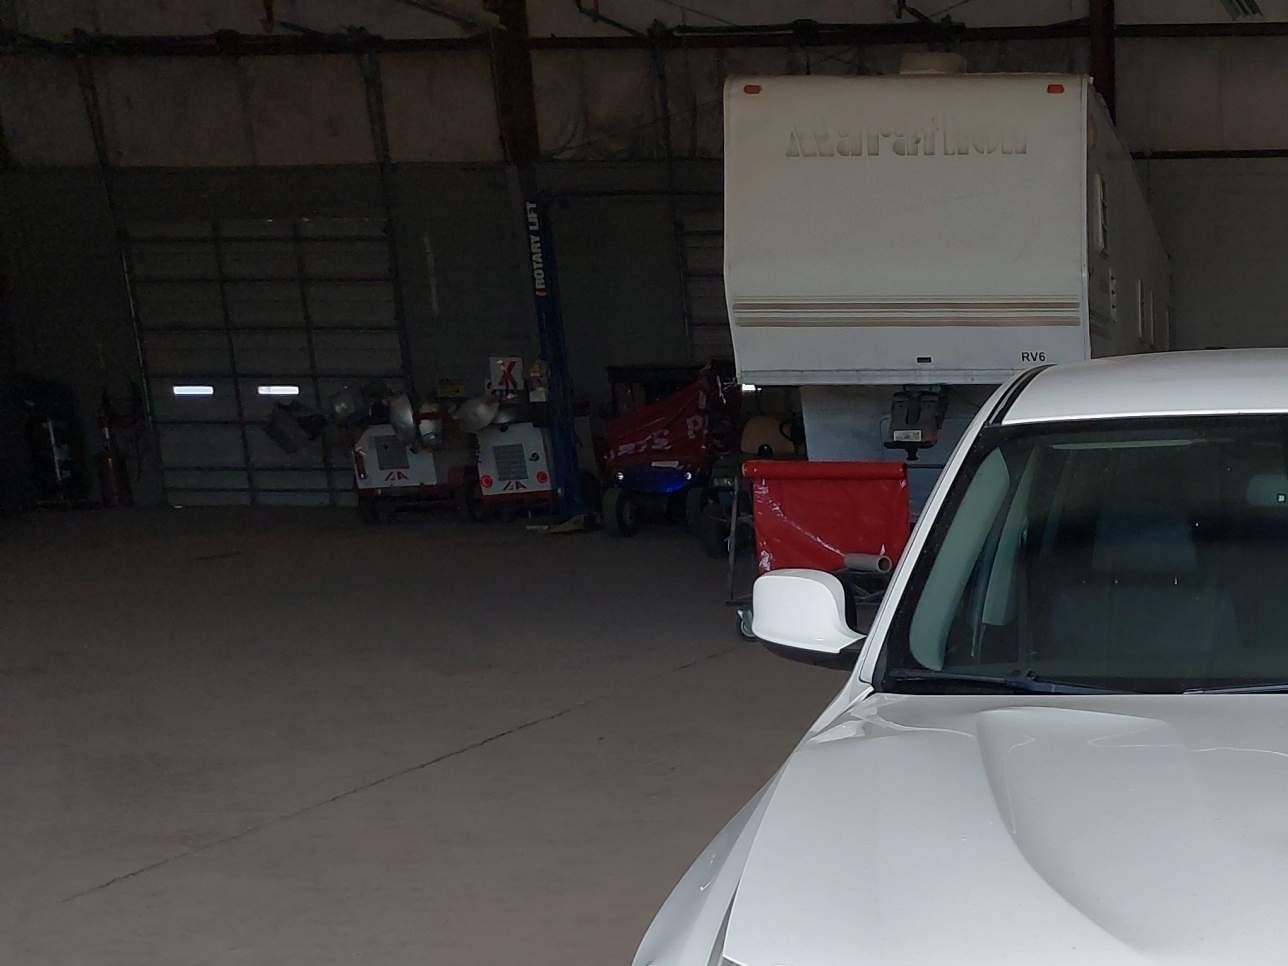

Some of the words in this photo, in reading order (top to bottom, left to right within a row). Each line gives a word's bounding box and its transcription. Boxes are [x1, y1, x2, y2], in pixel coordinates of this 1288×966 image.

[526, 201, 540, 231] LIFT
[529, 235, 546, 289] ROTARY
[1021, 351, 1047, 362] RV6
